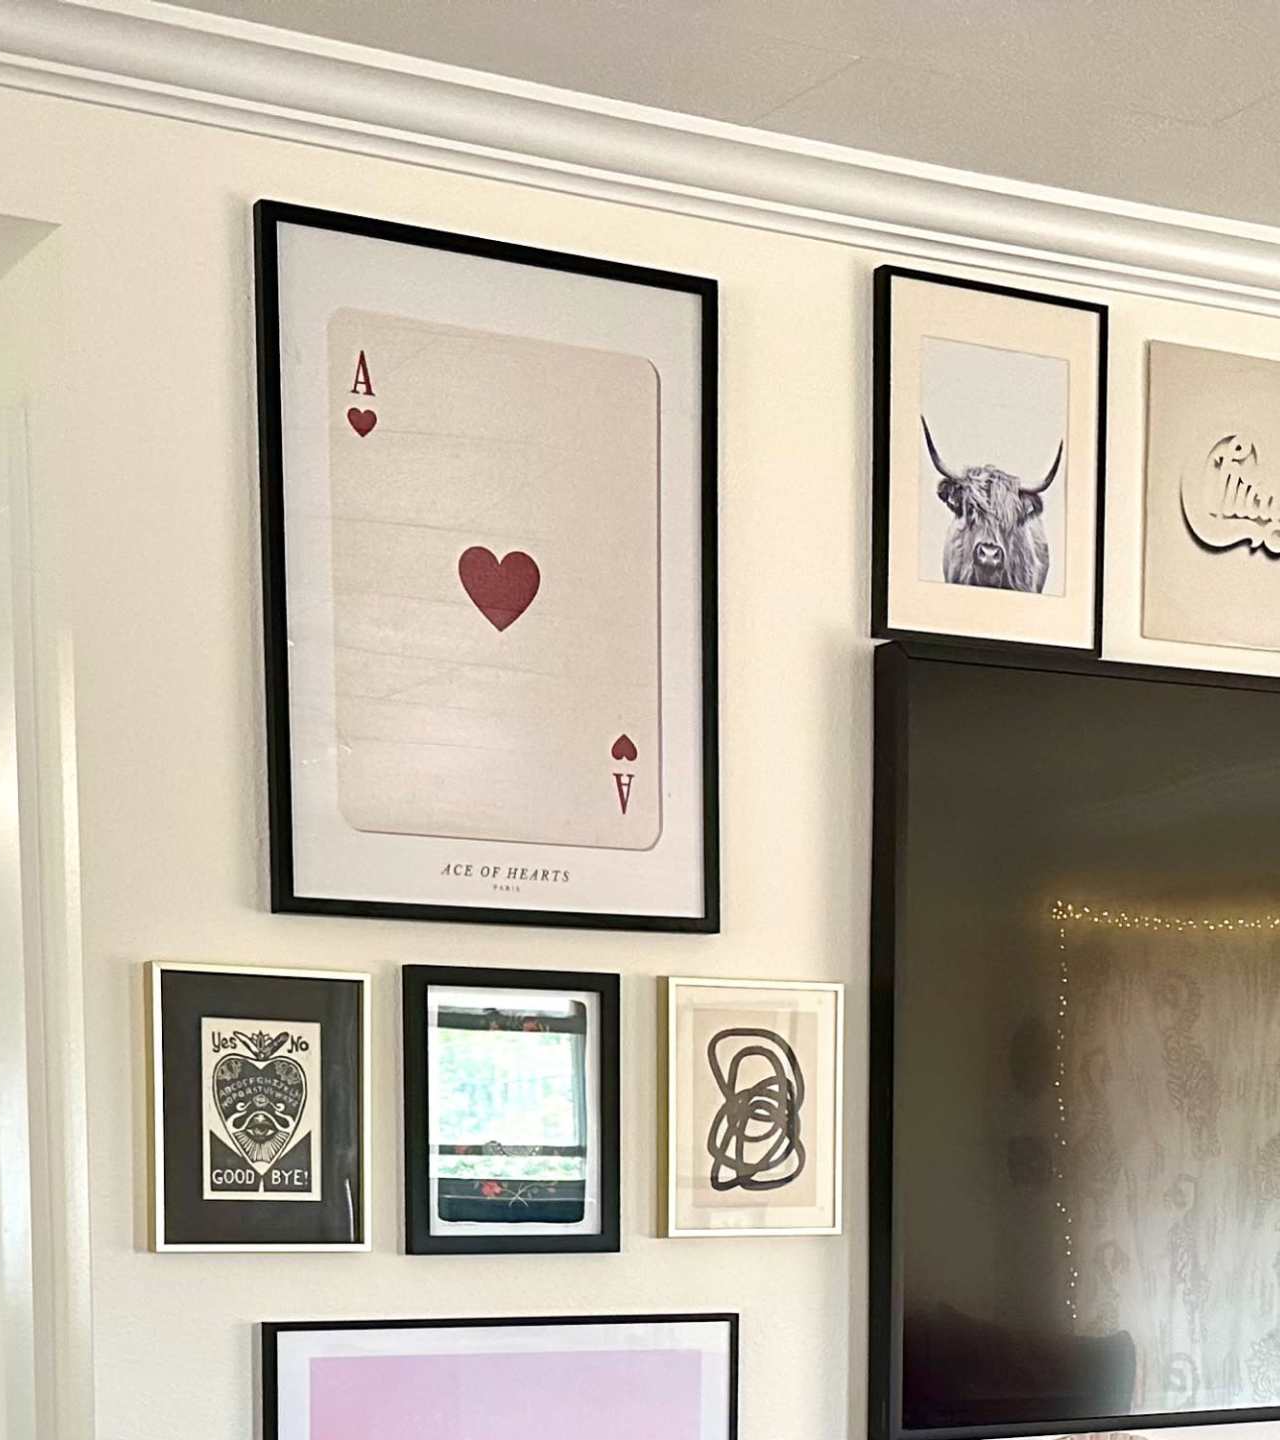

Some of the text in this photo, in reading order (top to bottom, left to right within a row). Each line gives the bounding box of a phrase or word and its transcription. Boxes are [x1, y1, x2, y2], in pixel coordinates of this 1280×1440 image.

[350, 350, 376, 397] A
[612, 773, 636, 815] A
[441, 863, 570, 882] ACE OF HEARTS
[211, 1031, 310, 1053] Yes No
[212, 1169, 309, 1186] GOOD BYE!
